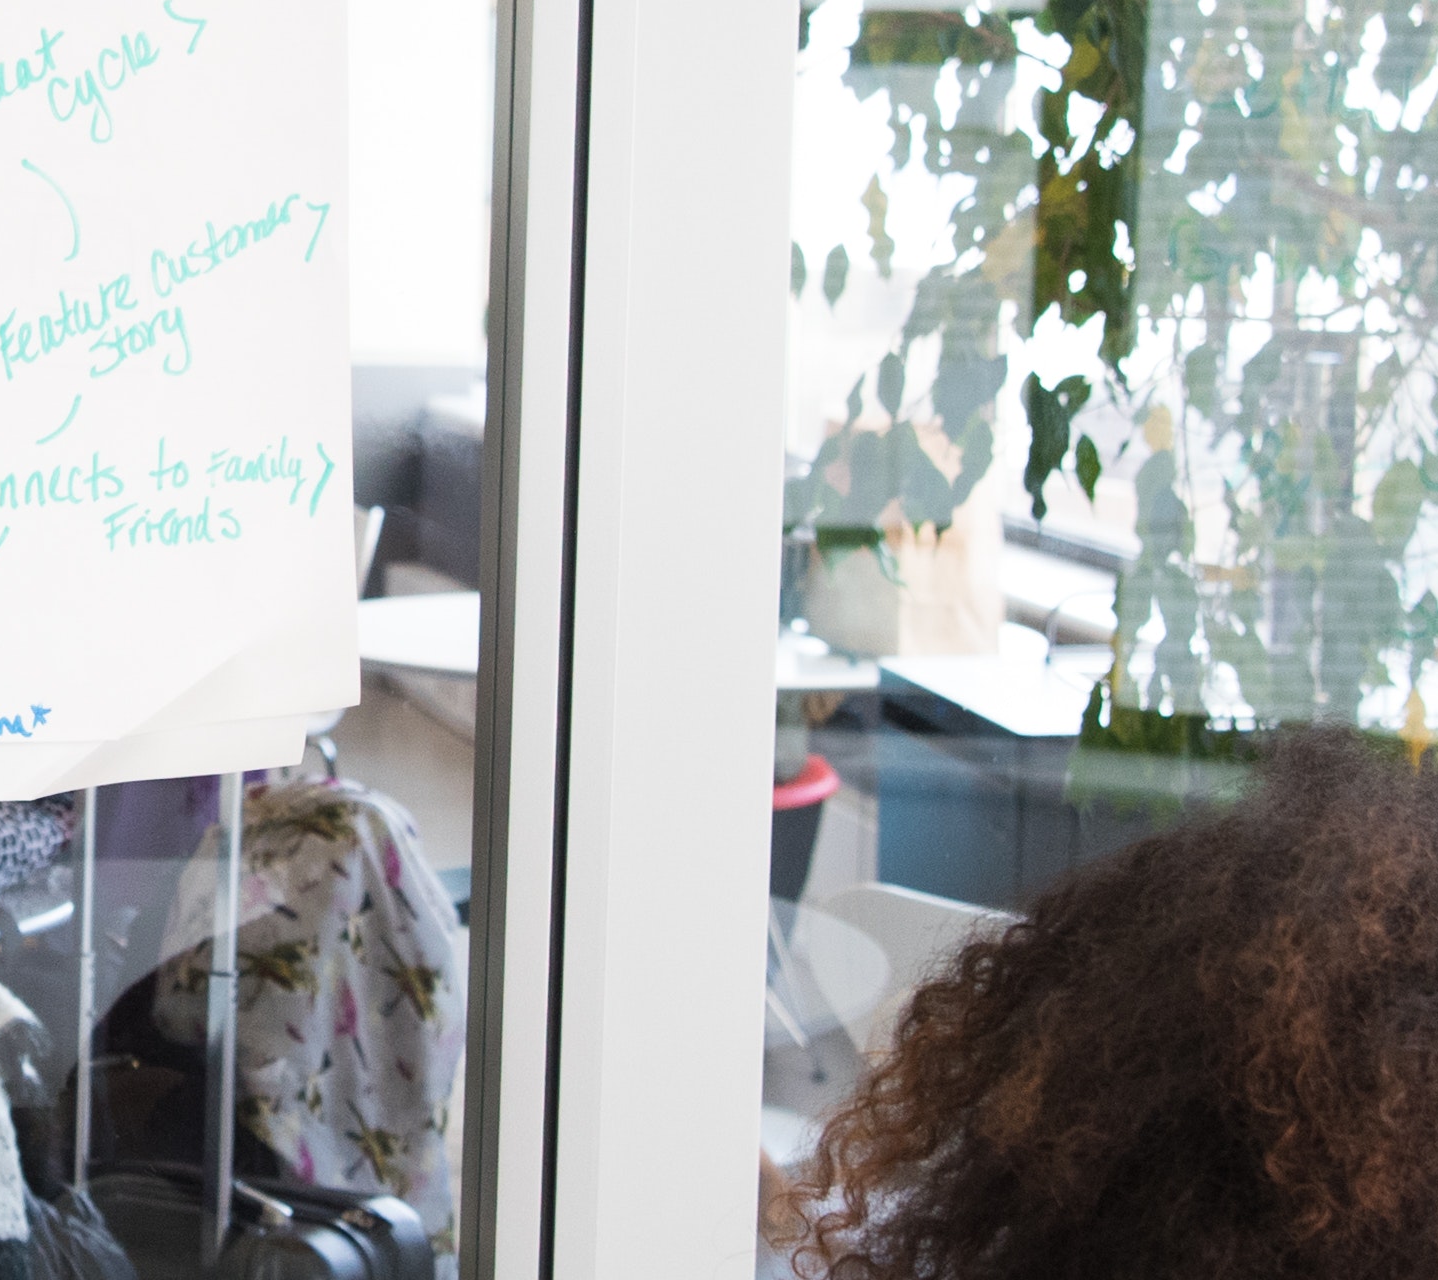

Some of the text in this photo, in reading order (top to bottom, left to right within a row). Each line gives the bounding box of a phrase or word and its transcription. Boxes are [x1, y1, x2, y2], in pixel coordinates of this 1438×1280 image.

[89, 306, 194, 378] Story
[149, 437, 191, 492] to
[102, 497, 243, 552] Friends
